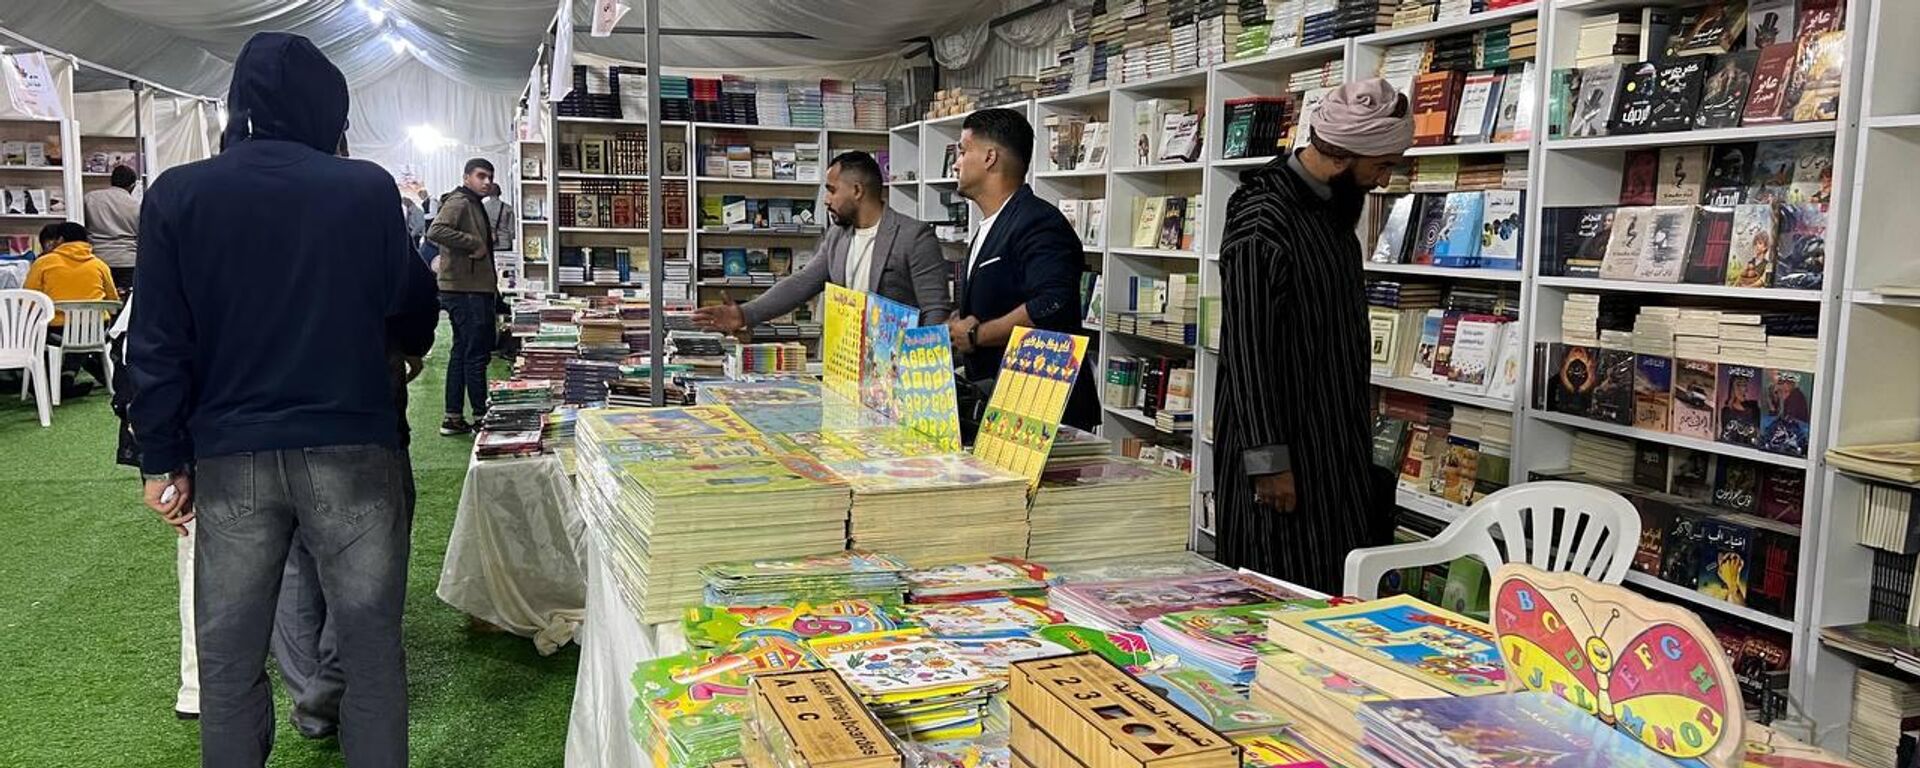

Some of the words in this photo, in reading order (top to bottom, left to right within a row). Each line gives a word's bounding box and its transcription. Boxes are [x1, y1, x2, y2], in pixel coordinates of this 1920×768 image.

[1501, 608, 1518, 629] A
[1515, 589, 1535, 611] B
[1542, 612, 1560, 634] C
[1564, 647, 1584, 671] D
[775, 679, 797, 687] A
[810, 676, 835, 696] Letter
[1037, 663, 1061, 671] 1
[1055, 676, 1081, 686] 2
[1074, 691, 1101, 701] 3
[1511, 644, 1522, 666] I
[1528, 667, 1543, 689] J
[1574, 684, 1593, 711] L
[1618, 667, 1640, 691] E
[1634, 642, 1654, 671] F
[1690, 663, 1717, 695] H
[785, 695, 809, 704] B
[797, 712, 820, 721] C
[1620, 704, 1647, 739] M
[1652, 725, 1677, 753] N
[1679, 721, 1702, 748] O
[1696, 705, 1719, 736] P
